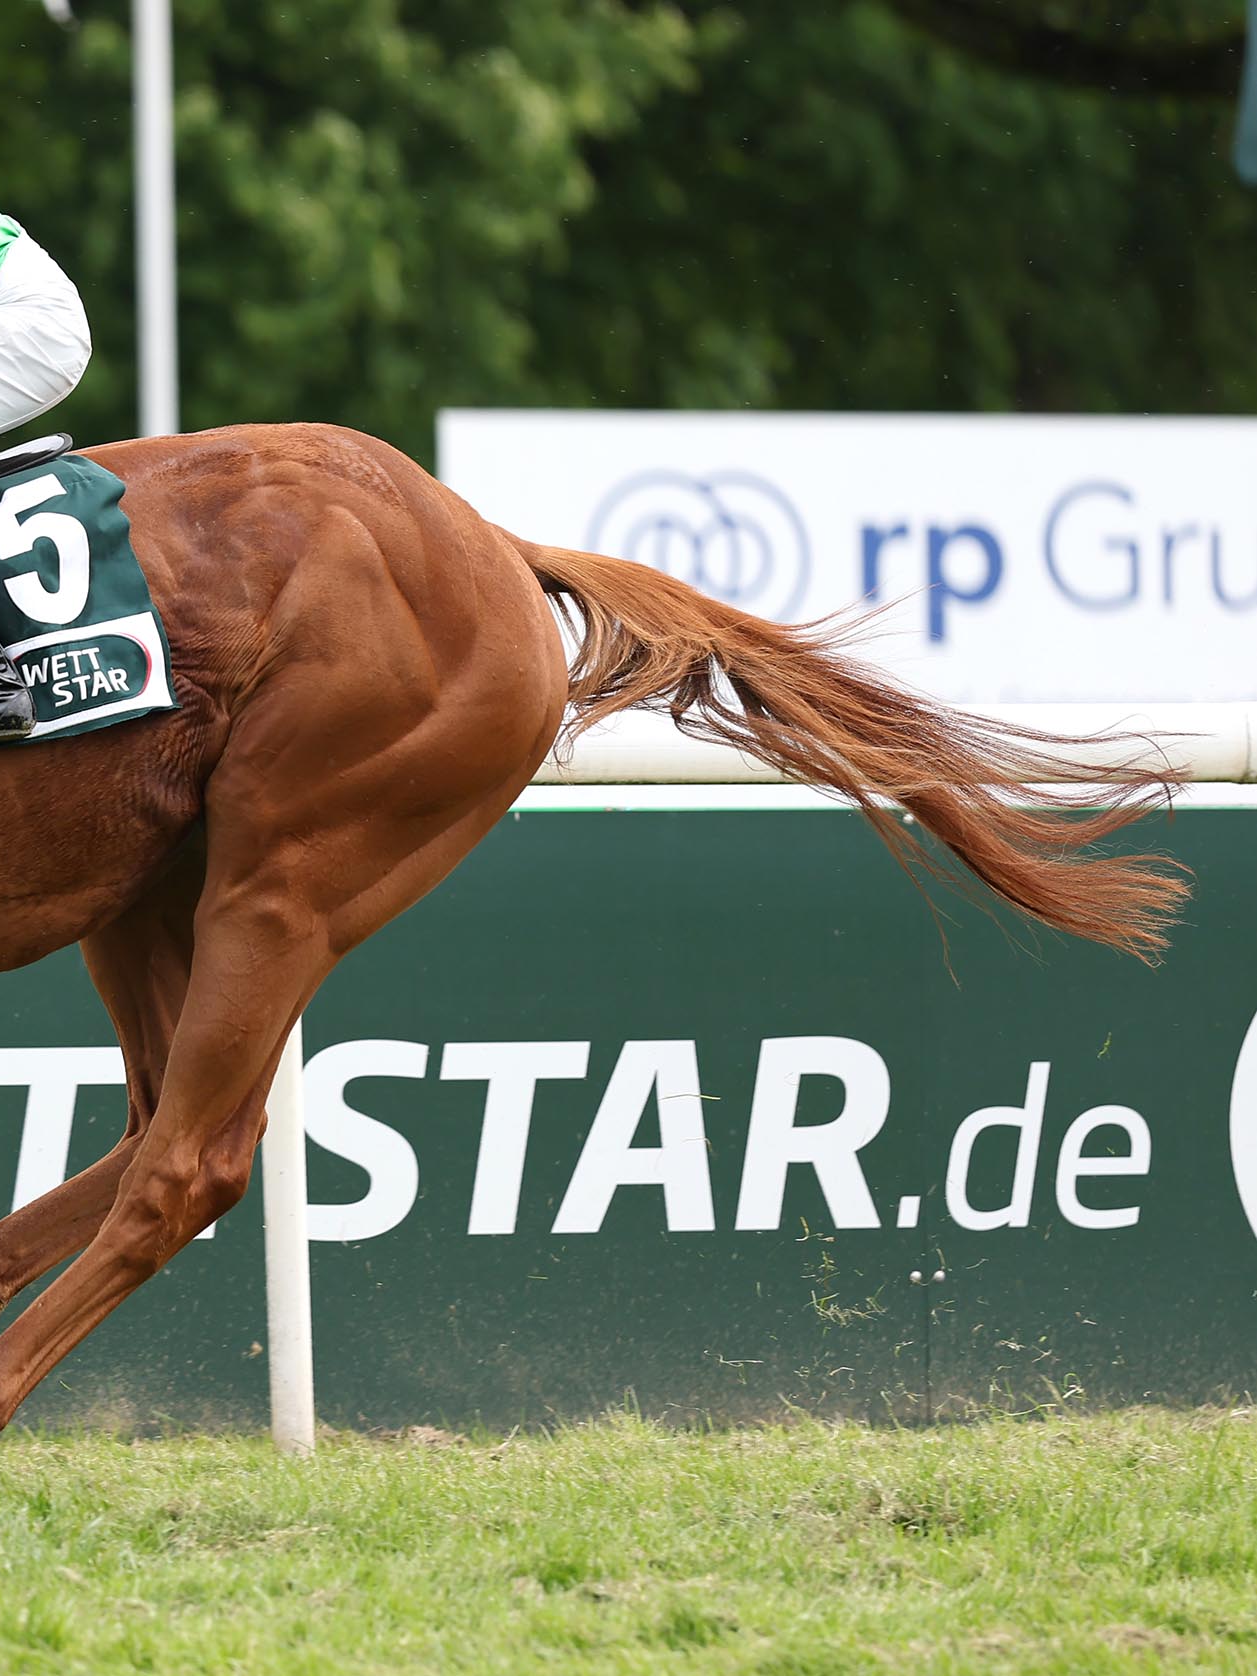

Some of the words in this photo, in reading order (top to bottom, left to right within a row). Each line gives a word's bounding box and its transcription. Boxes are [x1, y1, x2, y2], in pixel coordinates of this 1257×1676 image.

[860, 521, 1004, 643] rp
[22, 647, 100, 688] WETT
[52, 667, 130, 708] STAR
